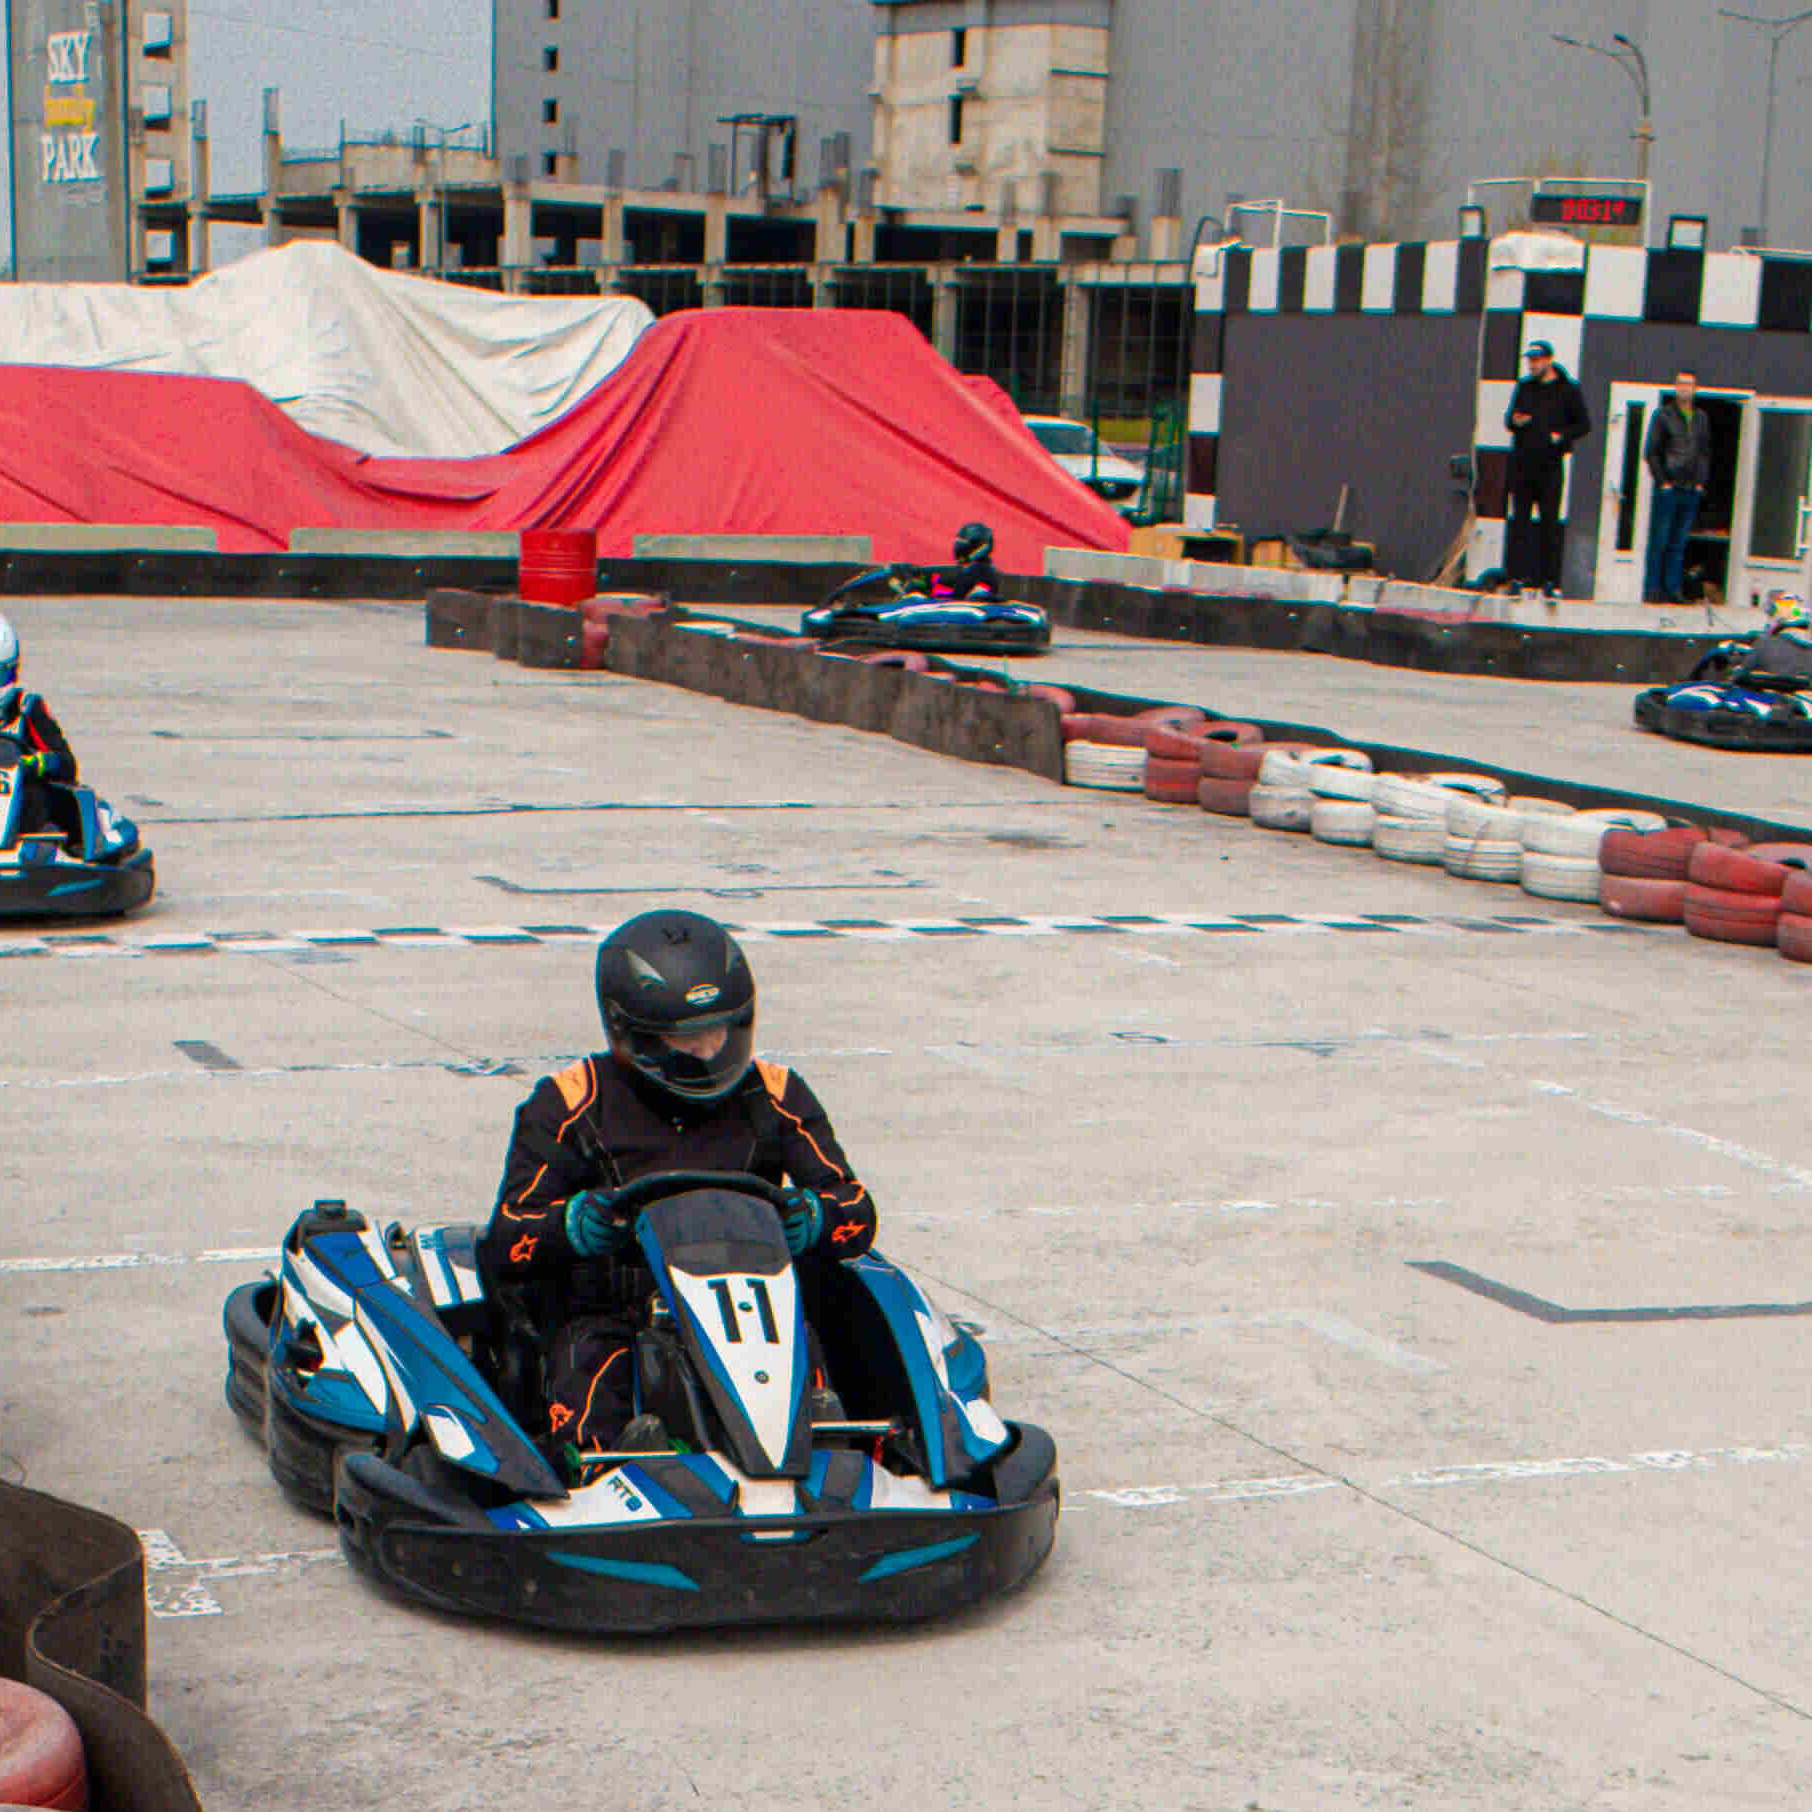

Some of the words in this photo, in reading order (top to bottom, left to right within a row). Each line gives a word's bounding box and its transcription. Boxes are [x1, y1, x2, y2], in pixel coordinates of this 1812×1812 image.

[46, 32, 92, 83] SKY
[41, 132, 100, 183] PARK
[707, 1278, 780, 1343] 11
